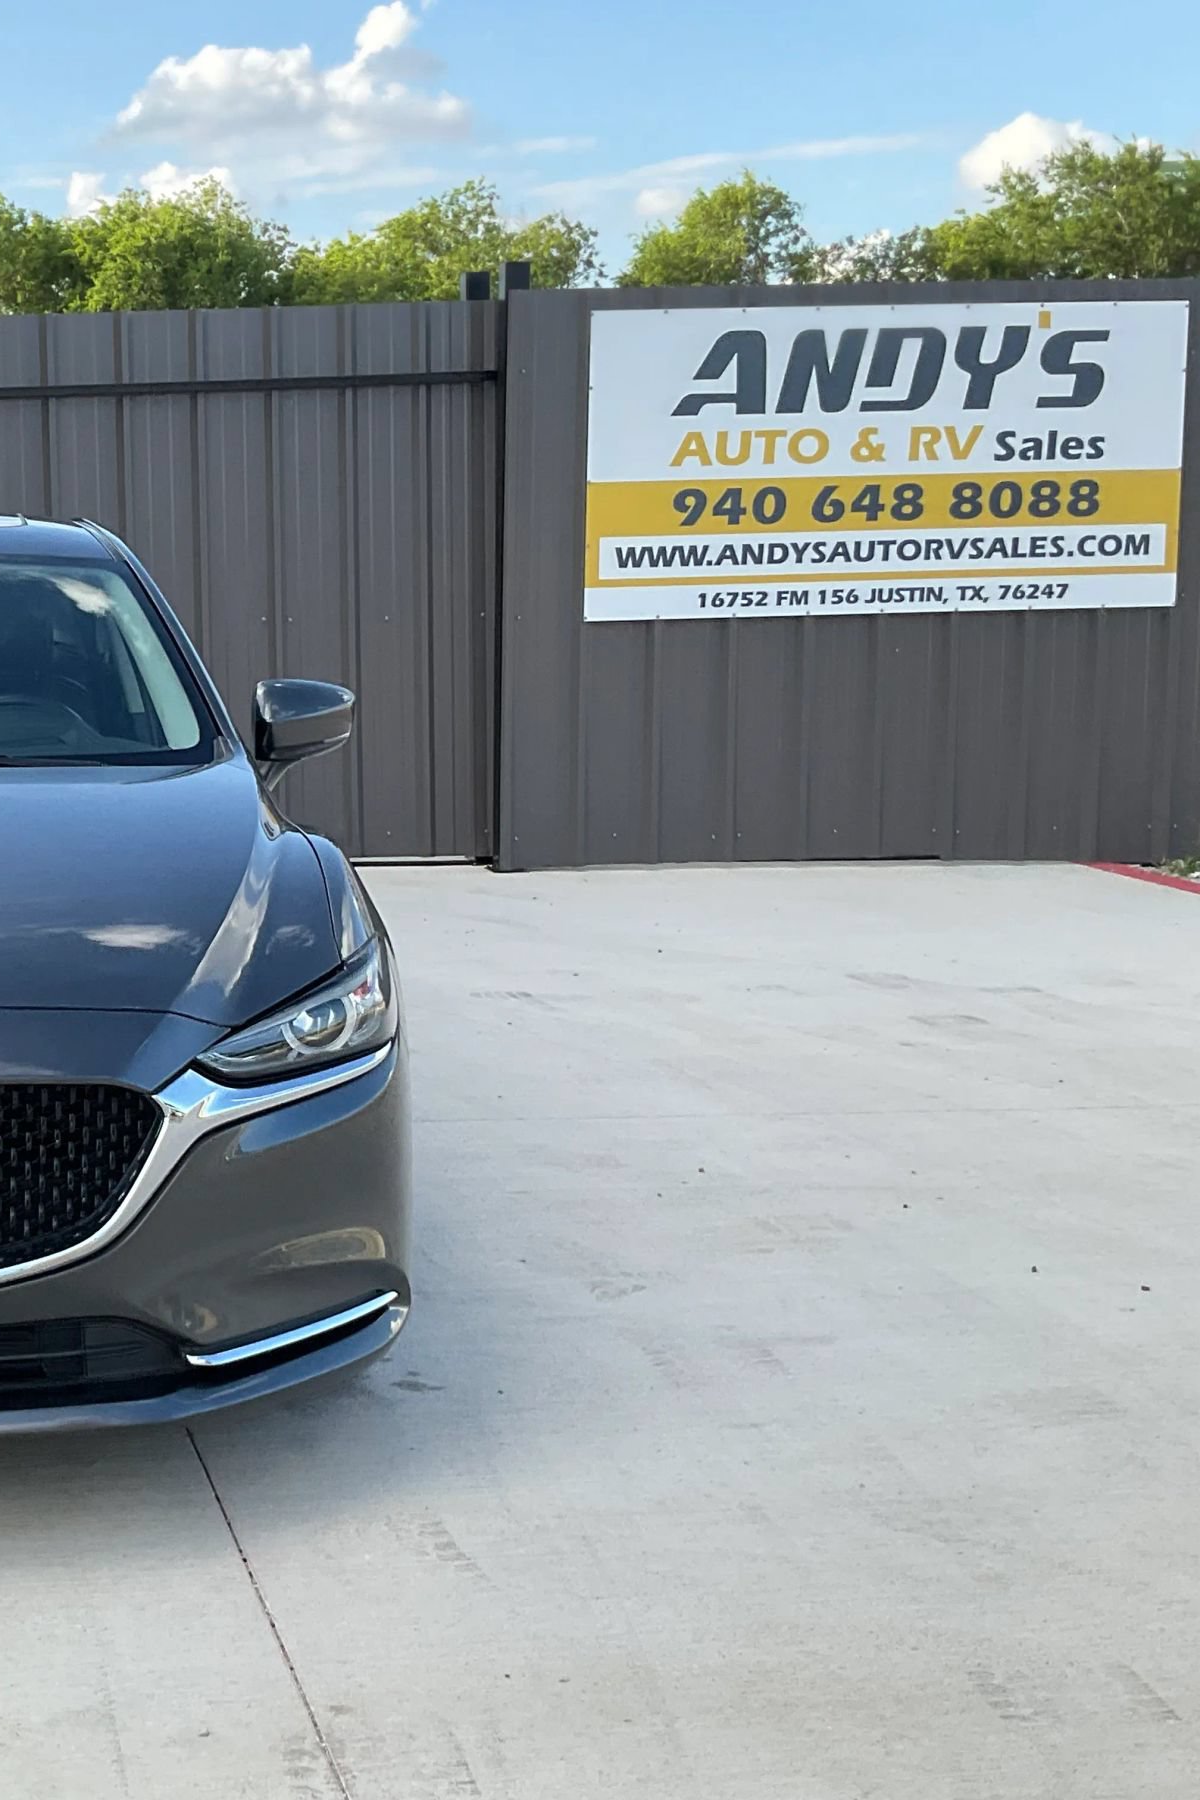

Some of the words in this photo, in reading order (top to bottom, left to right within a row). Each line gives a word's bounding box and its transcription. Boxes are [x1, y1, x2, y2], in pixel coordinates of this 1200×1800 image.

[670, 311, 1111, 417] ANDY'S
[669, 429, 830, 466] AUTO
[851, 428, 885, 462] &
[908, 425, 984, 460] RV
[993, 430, 1105, 462] Sales
[672, 487, 787, 526] 940
[811, 484, 923, 523] 648
[950, 480, 1099, 520] 8088
[615, 534, 1150, 569] WWW.ANDYSAUTORVSALES.COM
[698, 591, 769, 608] 16752
[776, 590, 809, 606] FM
[818, 588, 859, 605] 156
[865, 586, 948, 605] JUSTIN,
[956, 585, 990, 603] TX,
[998, 583, 1069, 600] 76247
